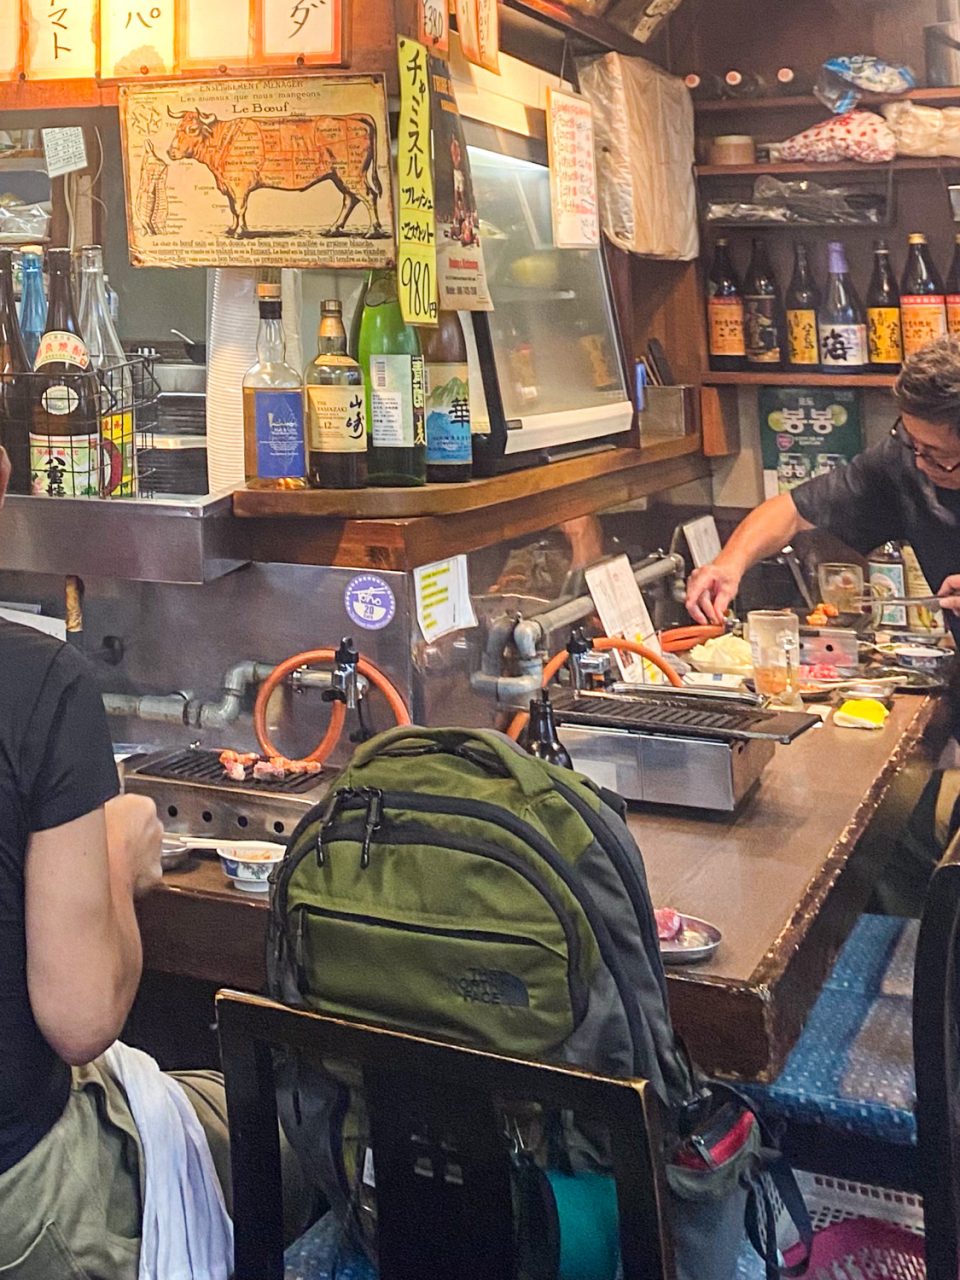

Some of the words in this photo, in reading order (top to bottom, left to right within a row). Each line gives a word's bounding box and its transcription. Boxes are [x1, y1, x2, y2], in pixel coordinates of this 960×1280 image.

[232, 104, 249, 114] Le
[406, 50, 427, 180] チャミスル
[401, 257, 437, 319] 980円
